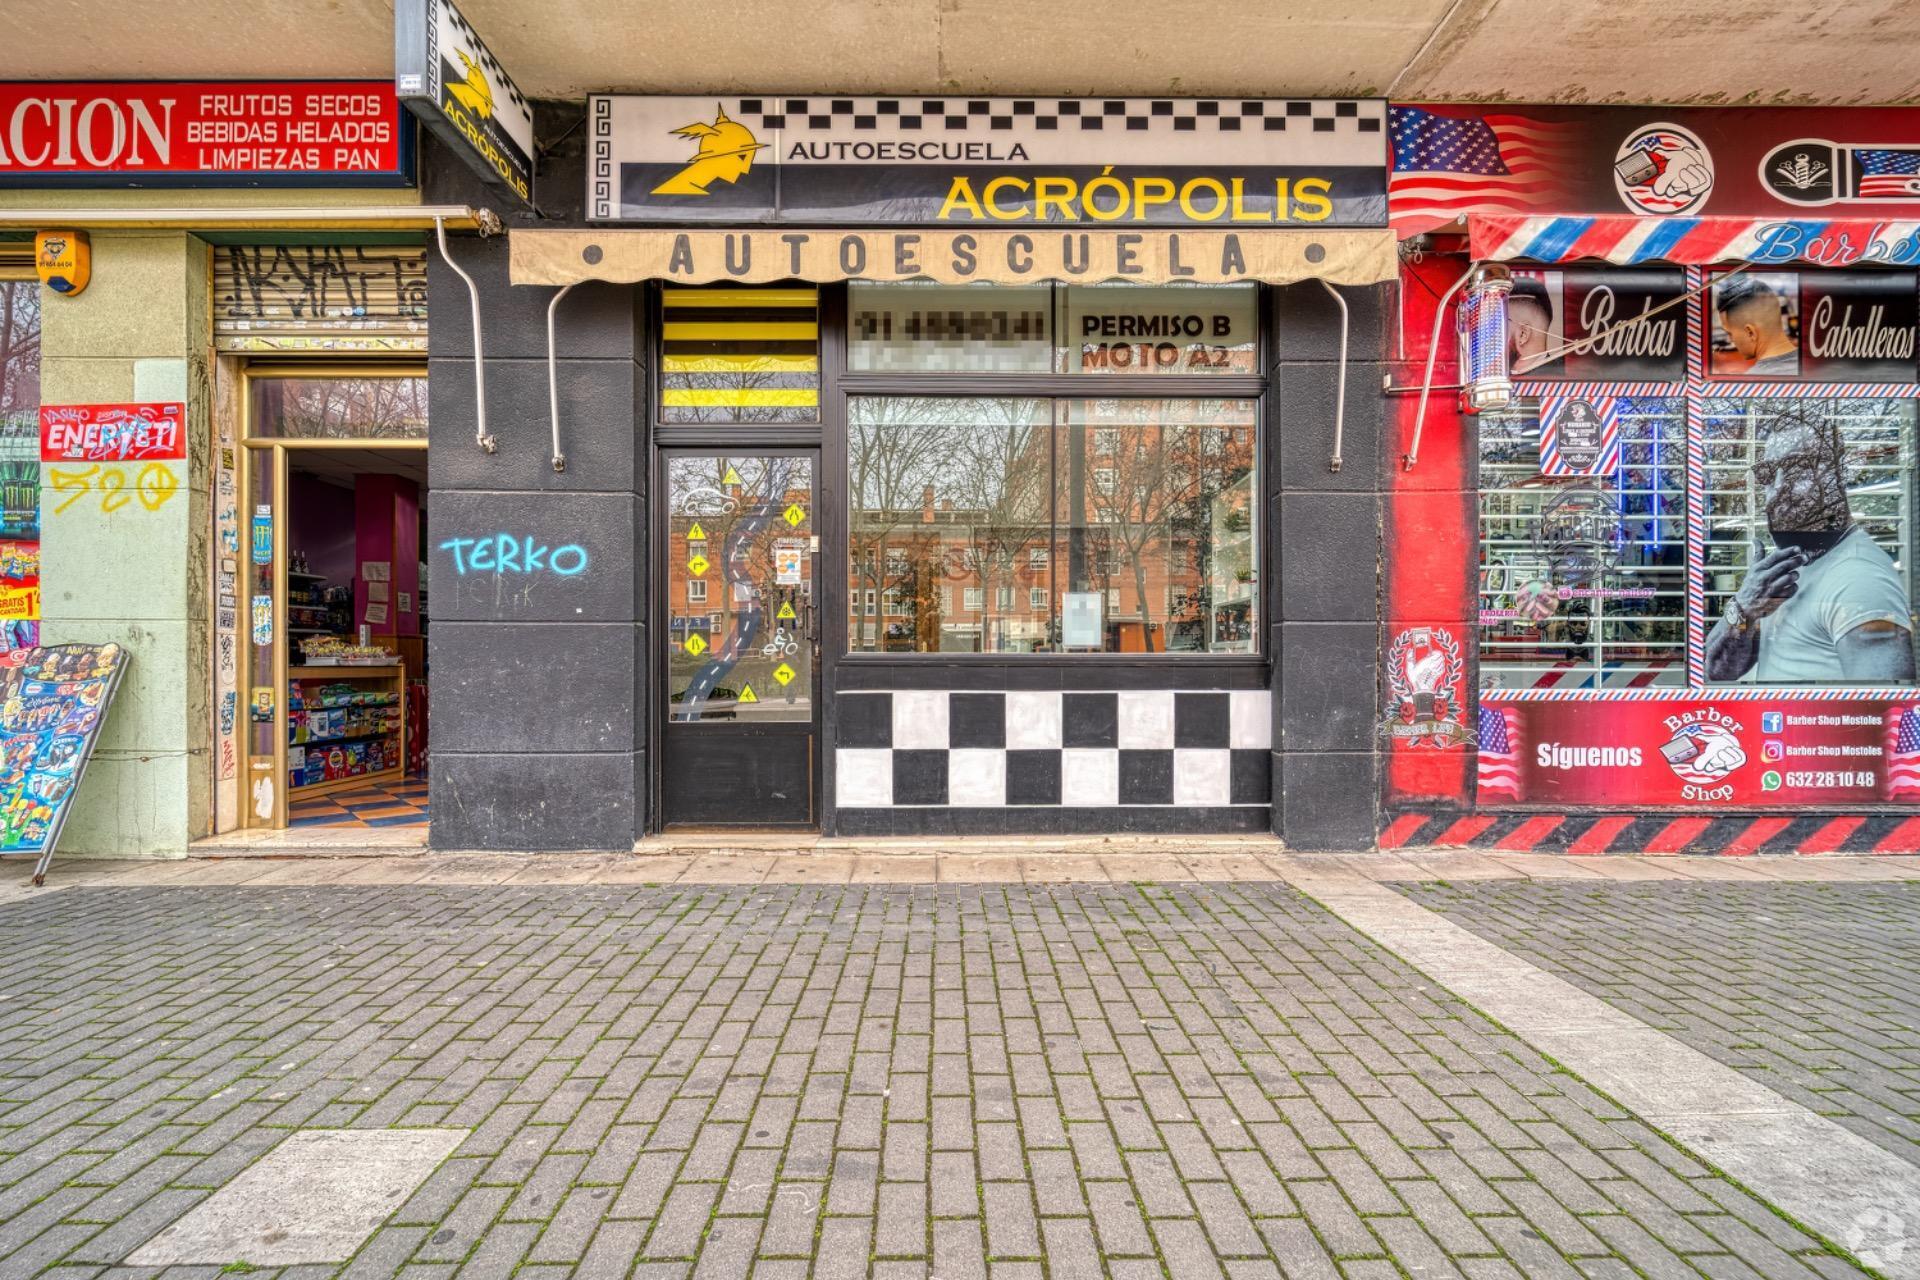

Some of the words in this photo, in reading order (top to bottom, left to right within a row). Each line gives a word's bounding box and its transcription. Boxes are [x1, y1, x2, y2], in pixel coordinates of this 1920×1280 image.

[200, 95, 292, 116] FRUTOS
[305, 95, 381, 116] SECOS
[0, 97, 176, 168] CION
[187, 122, 277, 143] BEBIDAS
[286, 122, 390, 143] HELADOS
[199, 149, 320, 170] LIMPIEZAS
[334, 149, 380, 170] PAN
[444, 99, 529, 199] ACRÓPOLIS
[788, 141, 1030, 161] AUTOESCUELA
[936, 165, 1334, 221] ACRÓPOLIS
[668, 233, 1247, 276] AUTOESCUELA
[1755, 222, 1920, 266] Barbe
[1082, 314, 1205, 337] PERMISO
[1213, 314, 1231, 336] B
[1574, 285, 1677, 357] Barbas
[1809, 295, 1917, 360] Caballeros
[1081, 343, 1179, 368] MOTO
[1189, 343, 1231, 368] A2
[439, 532, 588, 575] TERKO
[1662, 706, 1744, 733] Barber
[1786, 715, 1817, 726] Barber
[1817, 715, 1841, 726] Shop
[1841, 715, 1883, 726] Mostoles
[1536, 742, 1643, 770] Síguenos
[1786, 745, 1817, 756] Barber
[1817, 745, 1841, 756] Shop
[1841, 745, 1883, 756] Mostoles
[1785, 771, 1814, 787] 632
[1815, 771, 1835, 787] 28
[1836, 771, 1854, 787] 10
[1855, 771, 1875, 787] 48
[1681, 784, 1734, 801] Shop
